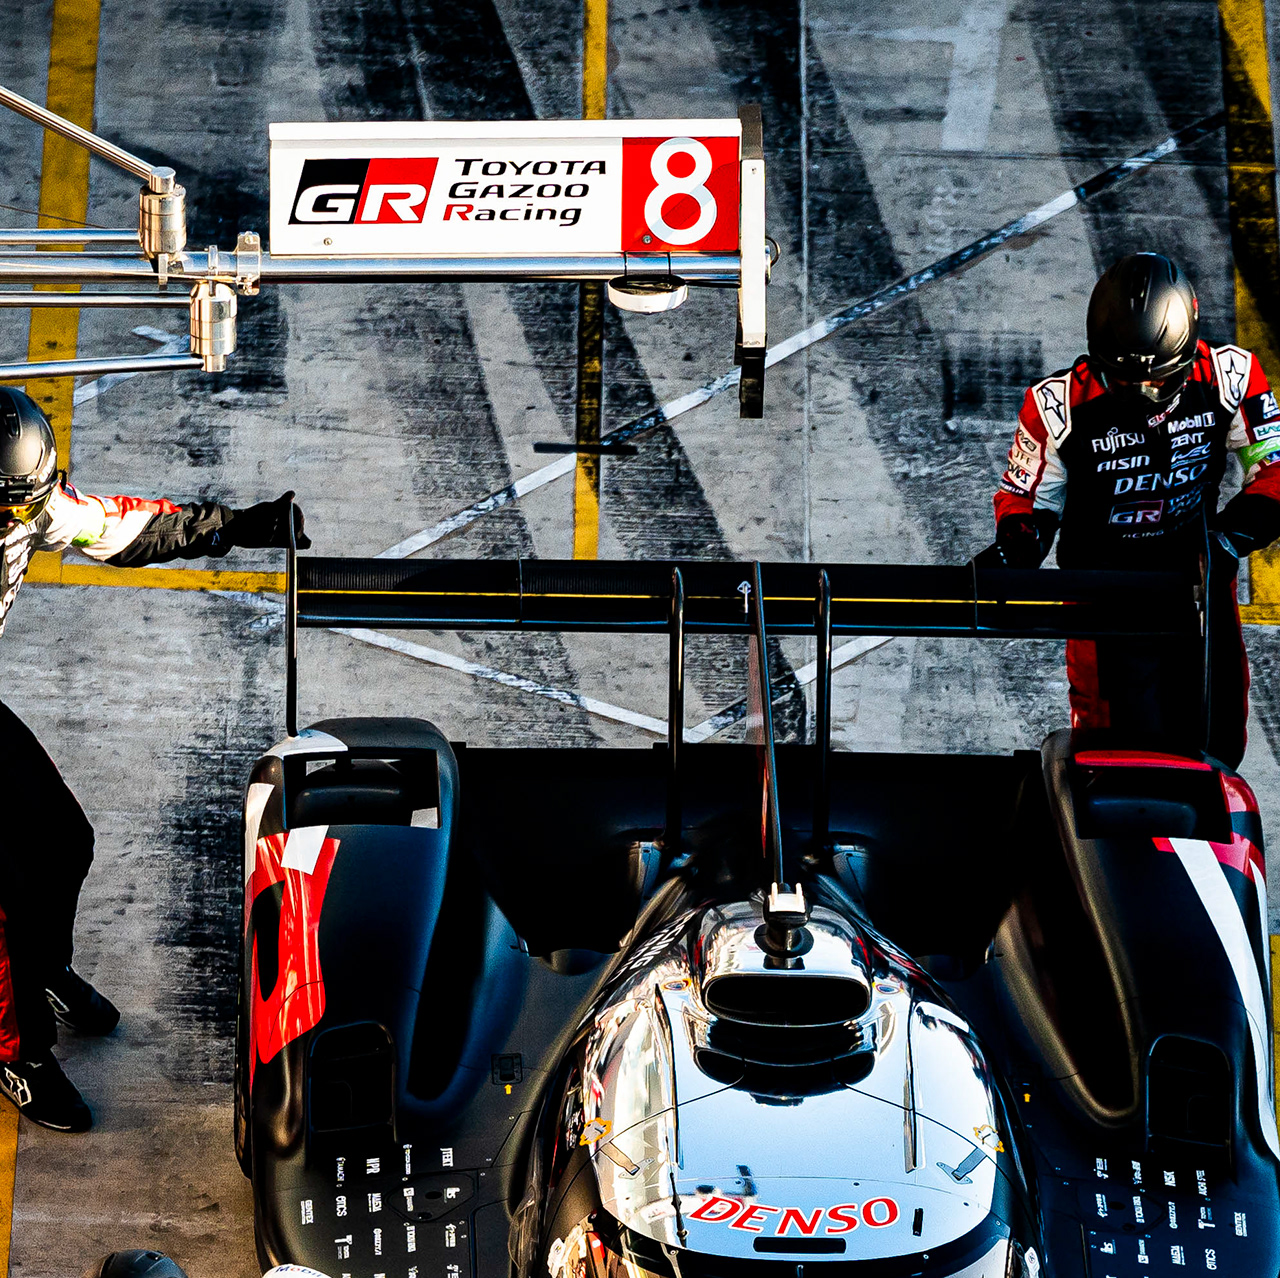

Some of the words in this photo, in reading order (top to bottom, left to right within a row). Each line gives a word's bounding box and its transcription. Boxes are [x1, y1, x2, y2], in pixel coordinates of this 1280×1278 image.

[454, 158, 606, 176] TOYOTA
[448, 182, 589, 199] GAZOO
[644, 138, 717, 245] 8
[295, 184, 429, 224] GR
[442, 202, 582, 226] Racing
[1091, 427, 1146, 454] FUJITSU
[1171, 432, 1205, 450] ZENT
[1097, 455, 1151, 472] AISIN
[1114, 463, 1208, 496] DENSO
[440, 1148, 454, 1167] JTEKT
[687, 1196, 900, 1236] DENSO
